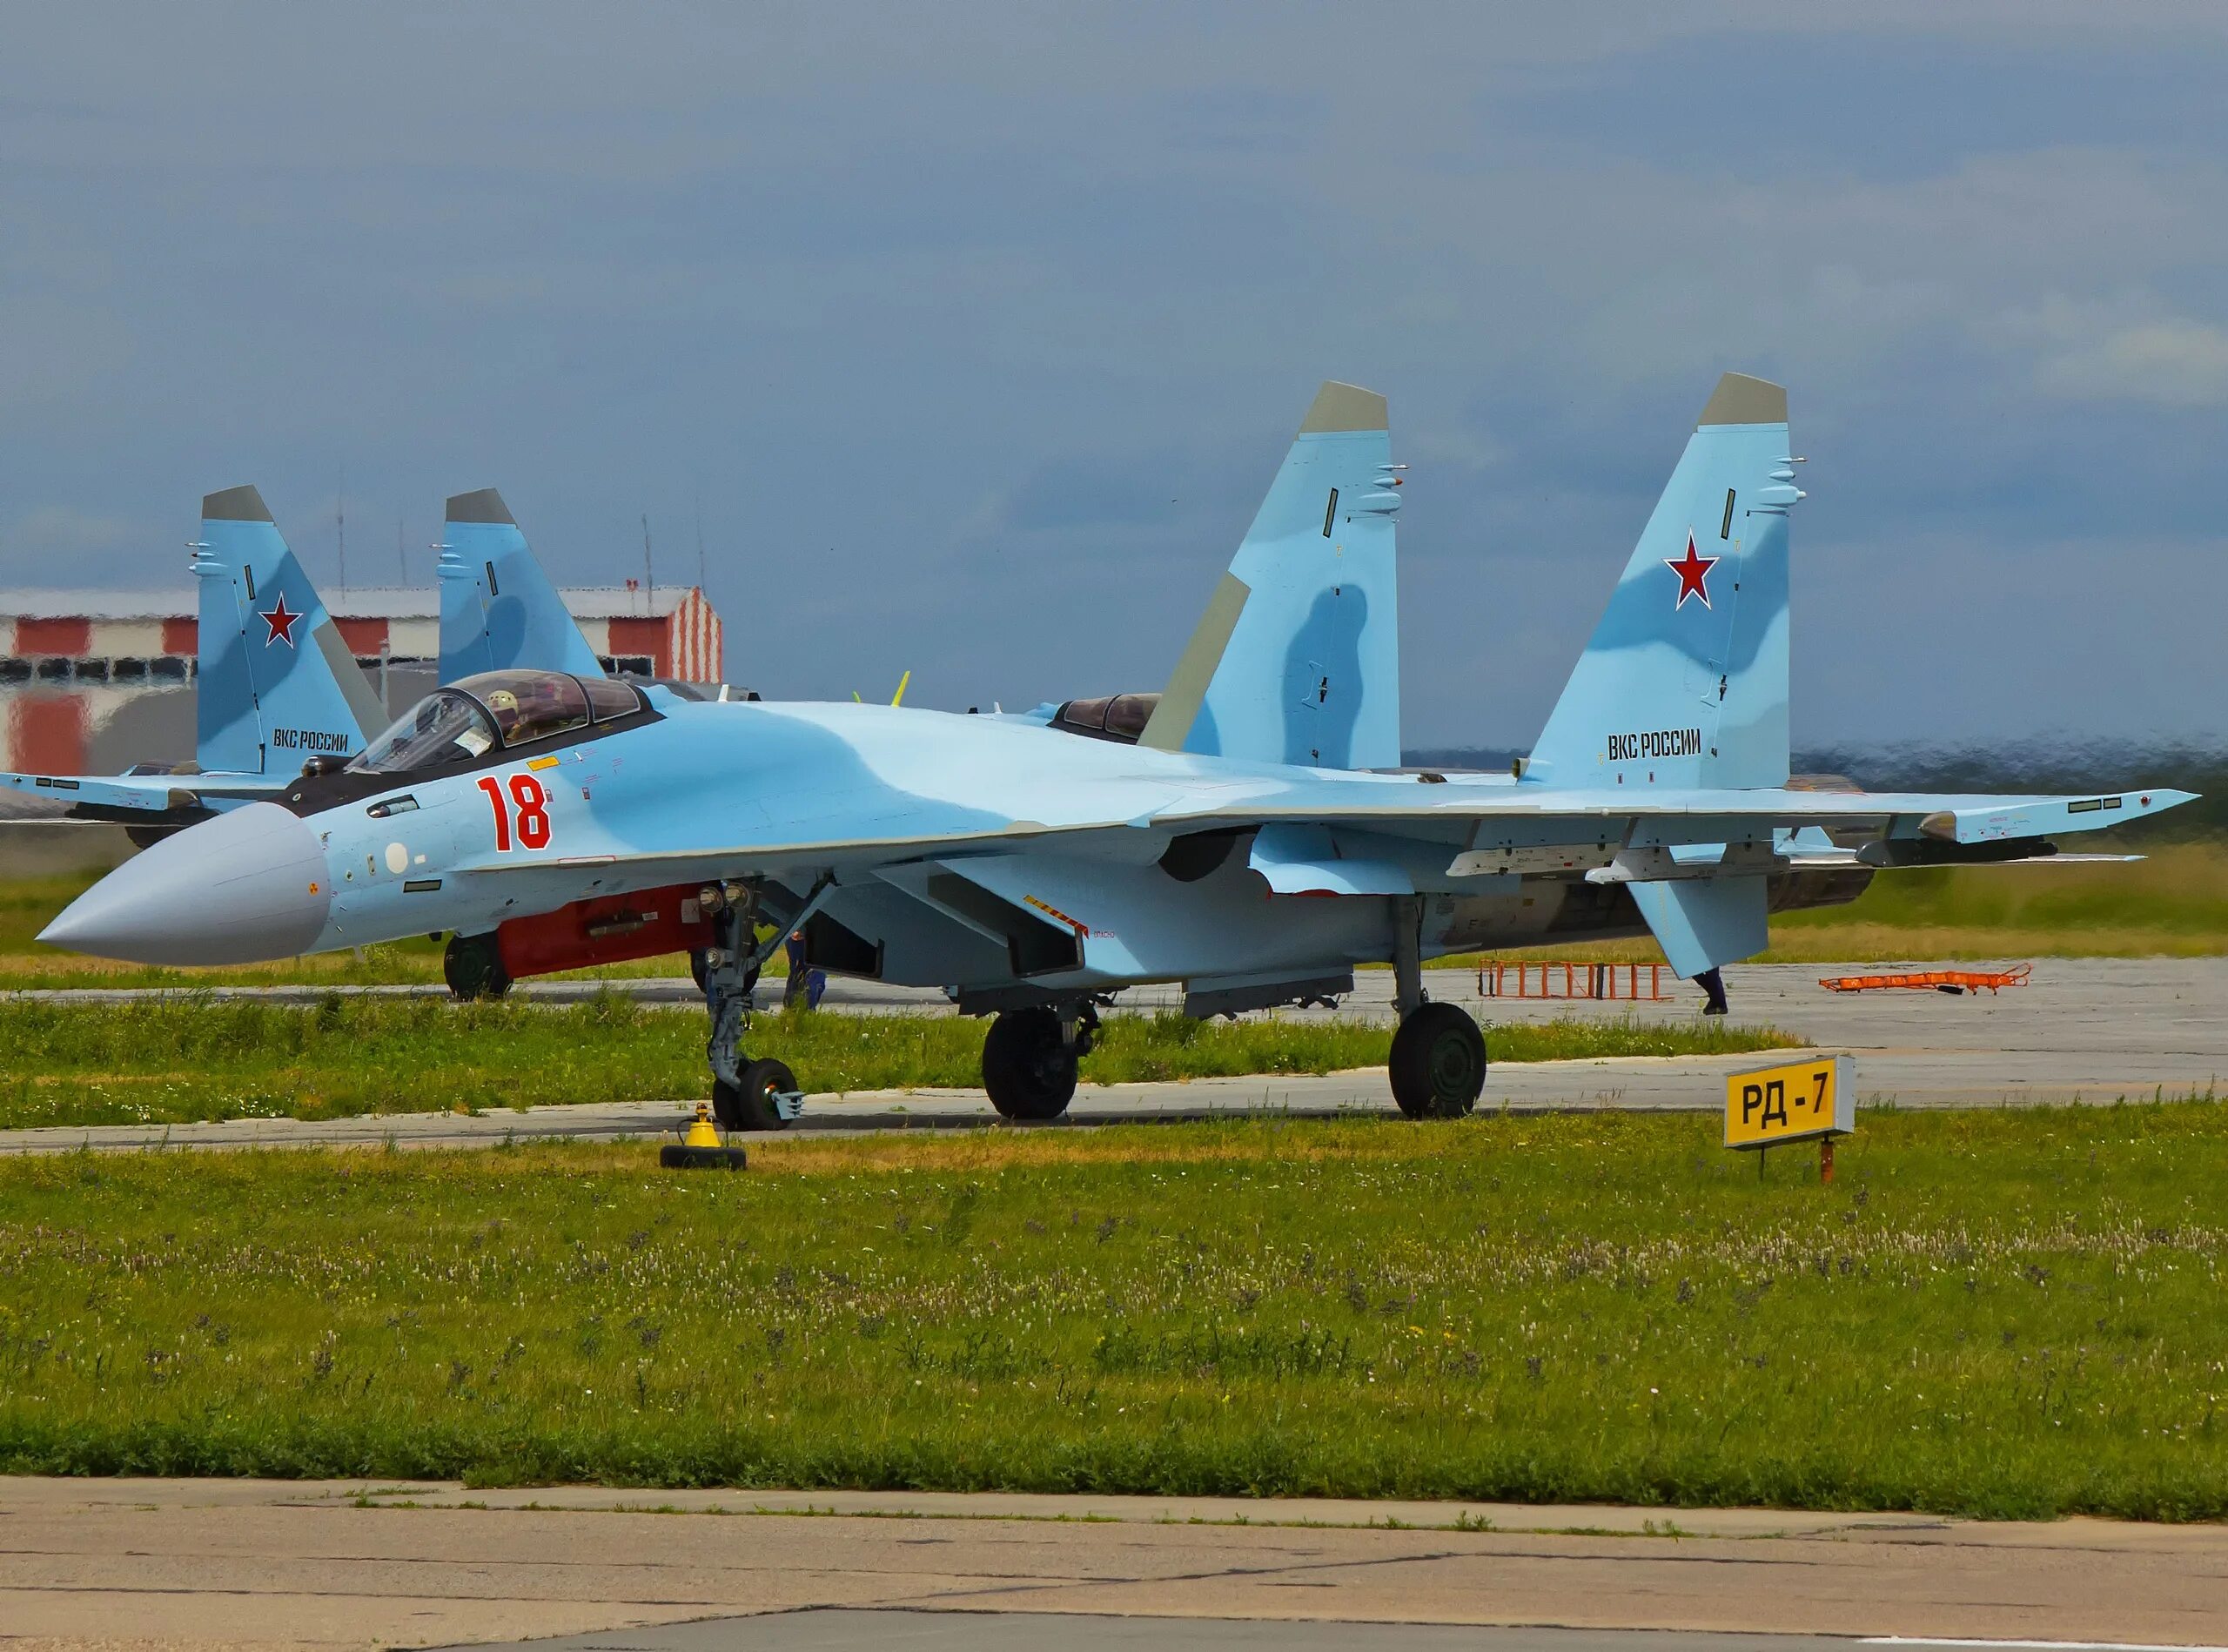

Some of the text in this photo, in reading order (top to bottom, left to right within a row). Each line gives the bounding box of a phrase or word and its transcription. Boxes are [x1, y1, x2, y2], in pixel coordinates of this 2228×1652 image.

[273, 729, 348, 752] ВКС РОССИИ
[1607, 728, 1701, 761] ВКС РОССИИ
[475, 773, 552, 853] 18
